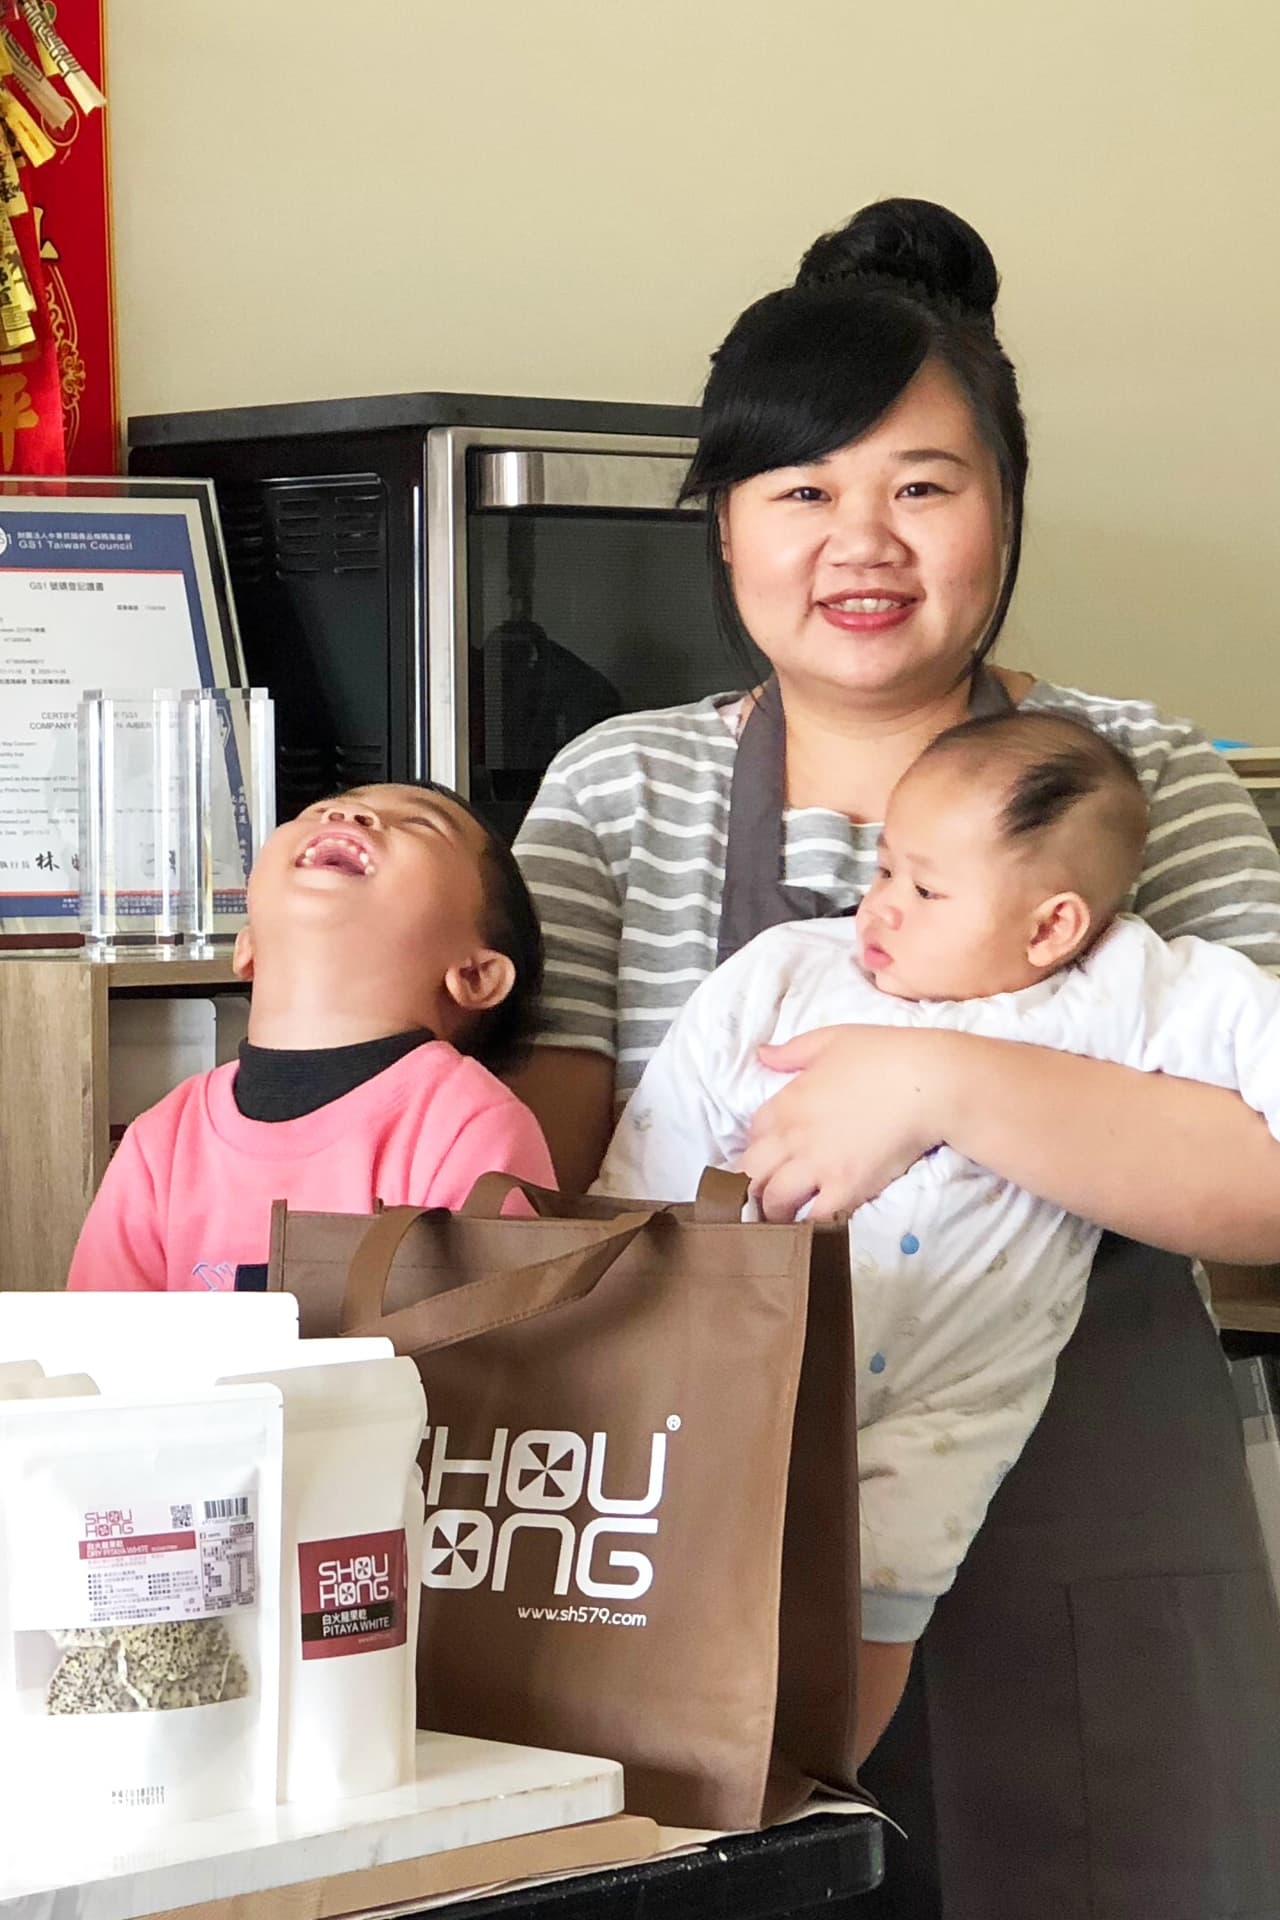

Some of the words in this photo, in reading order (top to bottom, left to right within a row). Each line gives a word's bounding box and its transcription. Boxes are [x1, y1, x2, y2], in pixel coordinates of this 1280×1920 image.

[18, 540, 42, 549] GS1
[47, 540, 86, 550] Taiwan
[90, 541, 133, 551] Council
[418, 1426, 667, 1515] HOU
[84, 1508, 133, 1525] SHOU
[85, 1521, 134, 1537] HONG
[420, 1508, 660, 1600] ONG
[318, 1553, 389, 1586] SHOU
[319, 1576, 390, 1609] HONG
[323, 1622, 360, 1637] PITAYA
[360, 1616, 391, 1632] WHITE
[517, 1605, 647, 1628] www.sh579.com
